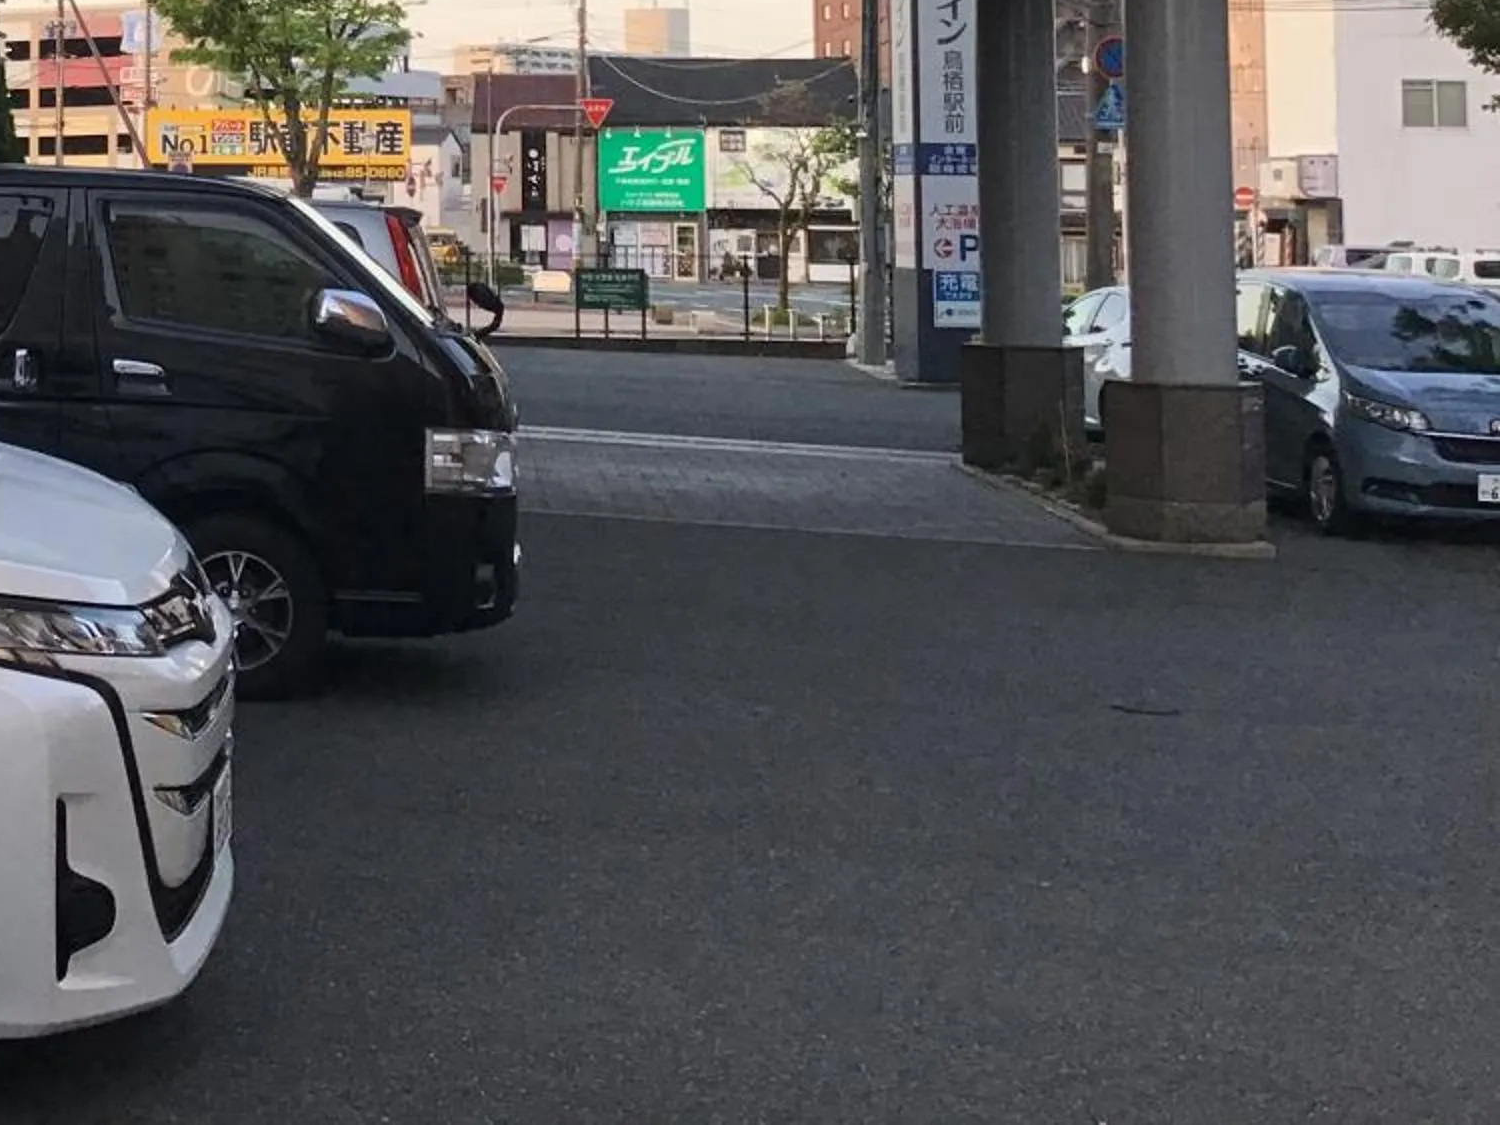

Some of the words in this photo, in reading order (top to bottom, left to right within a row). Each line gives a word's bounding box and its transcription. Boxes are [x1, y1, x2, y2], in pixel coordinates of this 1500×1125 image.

[942, 50, 965, 134] 鳥栖駅前
[608, 138, 697, 174] エイブル
[959, 235, 979, 262] P
